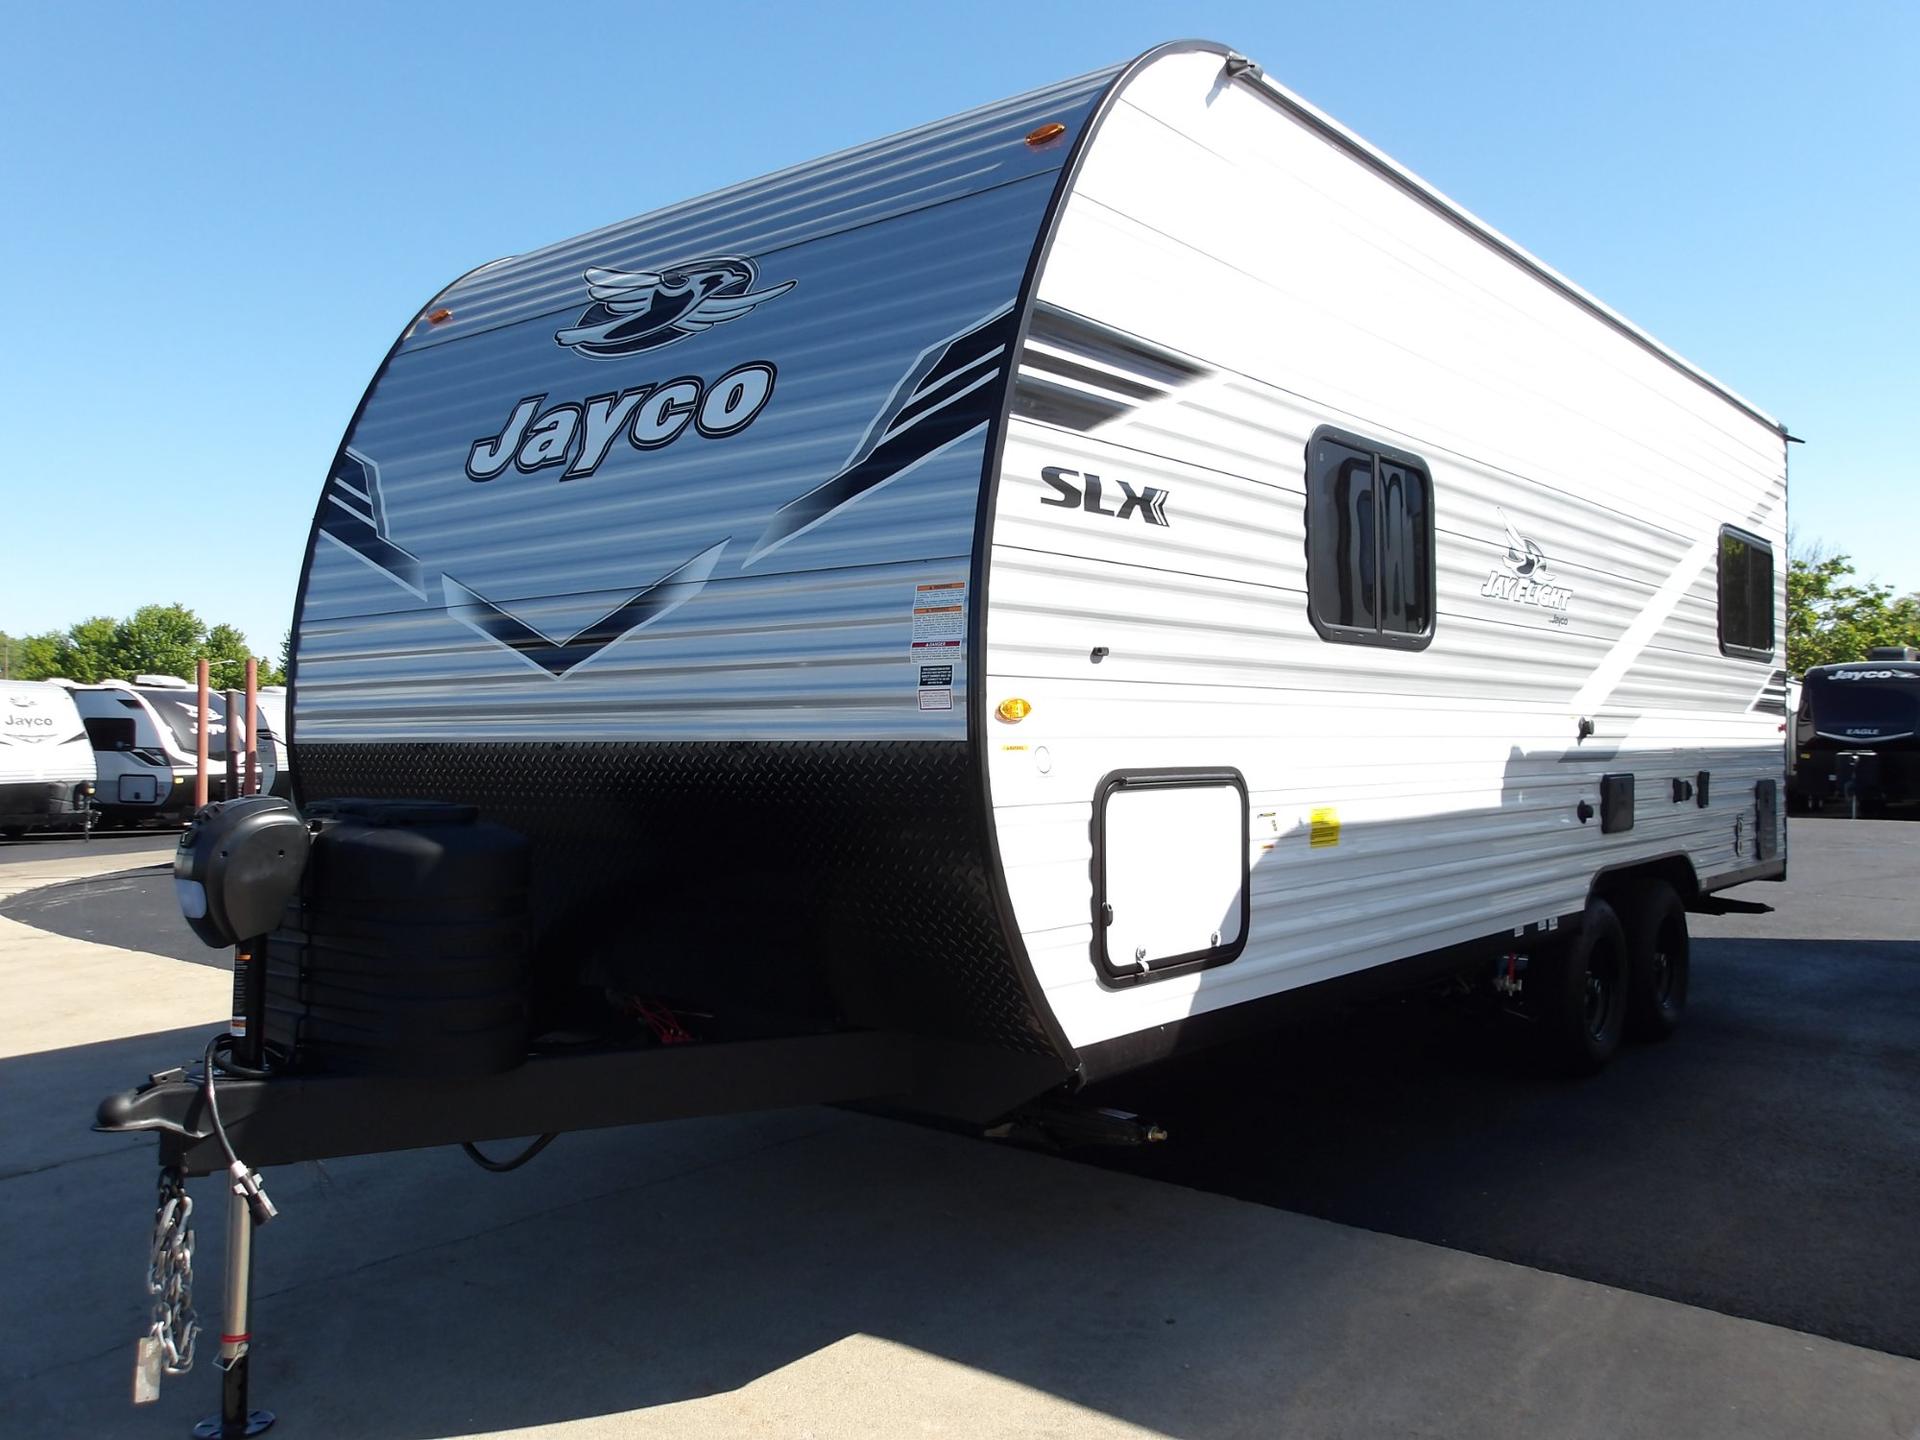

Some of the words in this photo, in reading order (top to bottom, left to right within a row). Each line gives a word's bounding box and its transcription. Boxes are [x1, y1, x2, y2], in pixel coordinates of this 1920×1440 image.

[465, 360, 778, 482] Jayco
[1041, 466, 1168, 527] SLX
[1828, 670, 1892, 681] Jayco
[4, 714, 53, 728] Jayco
